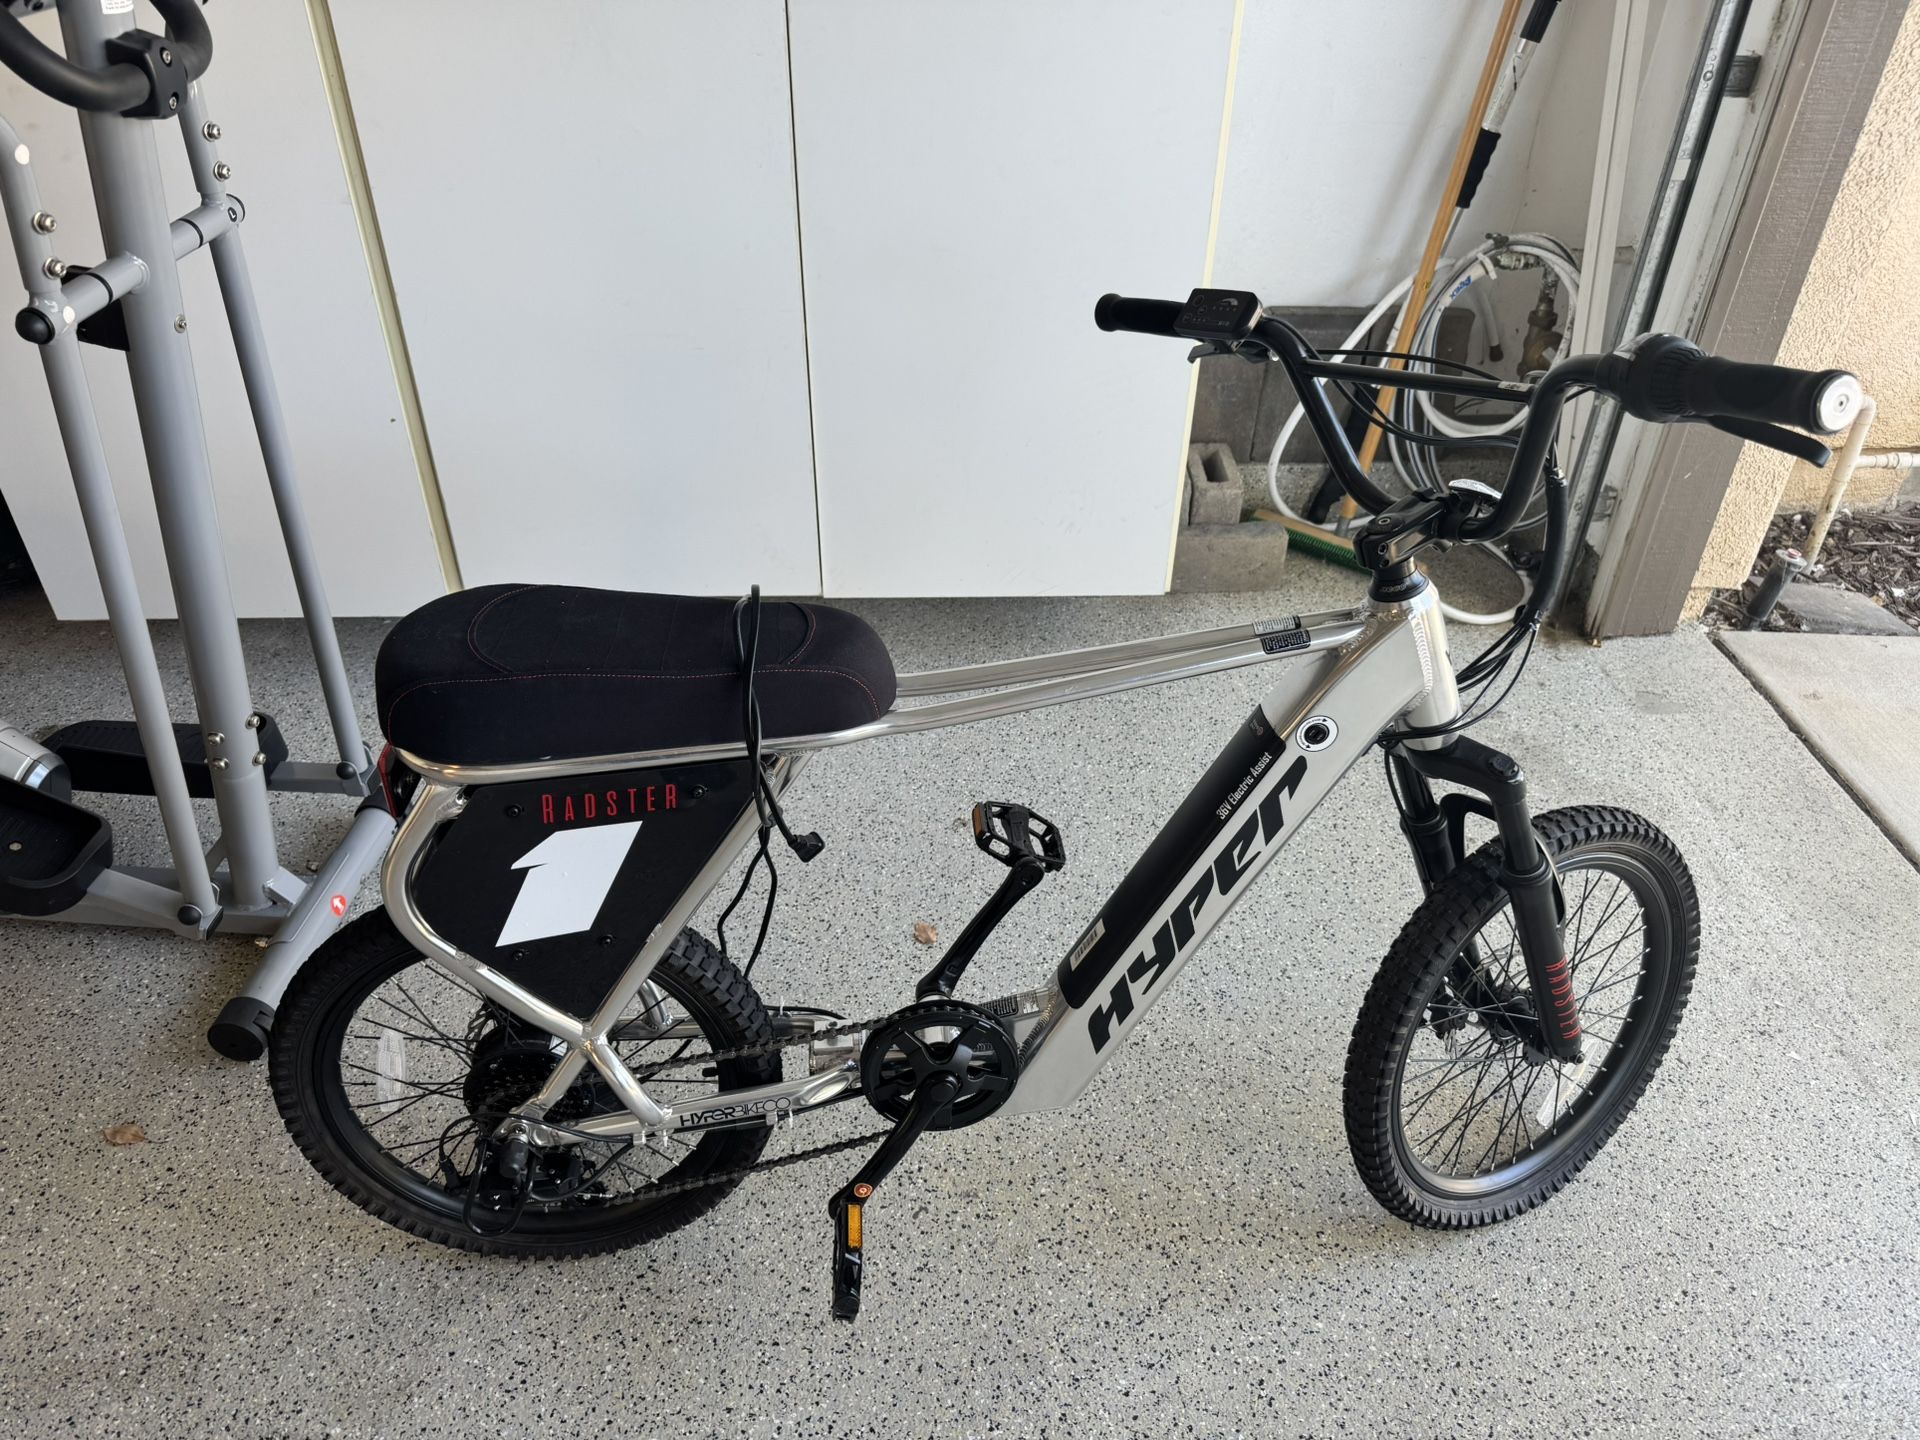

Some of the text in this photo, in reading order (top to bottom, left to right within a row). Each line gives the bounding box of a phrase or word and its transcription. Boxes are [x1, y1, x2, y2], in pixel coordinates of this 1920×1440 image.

[1216, 800, 1232, 820] 36V
[1227, 775, 1255, 805] Electric
[1249, 751, 1273, 778] Assist
[1544, 953, 1583, 1040] RADSTER
